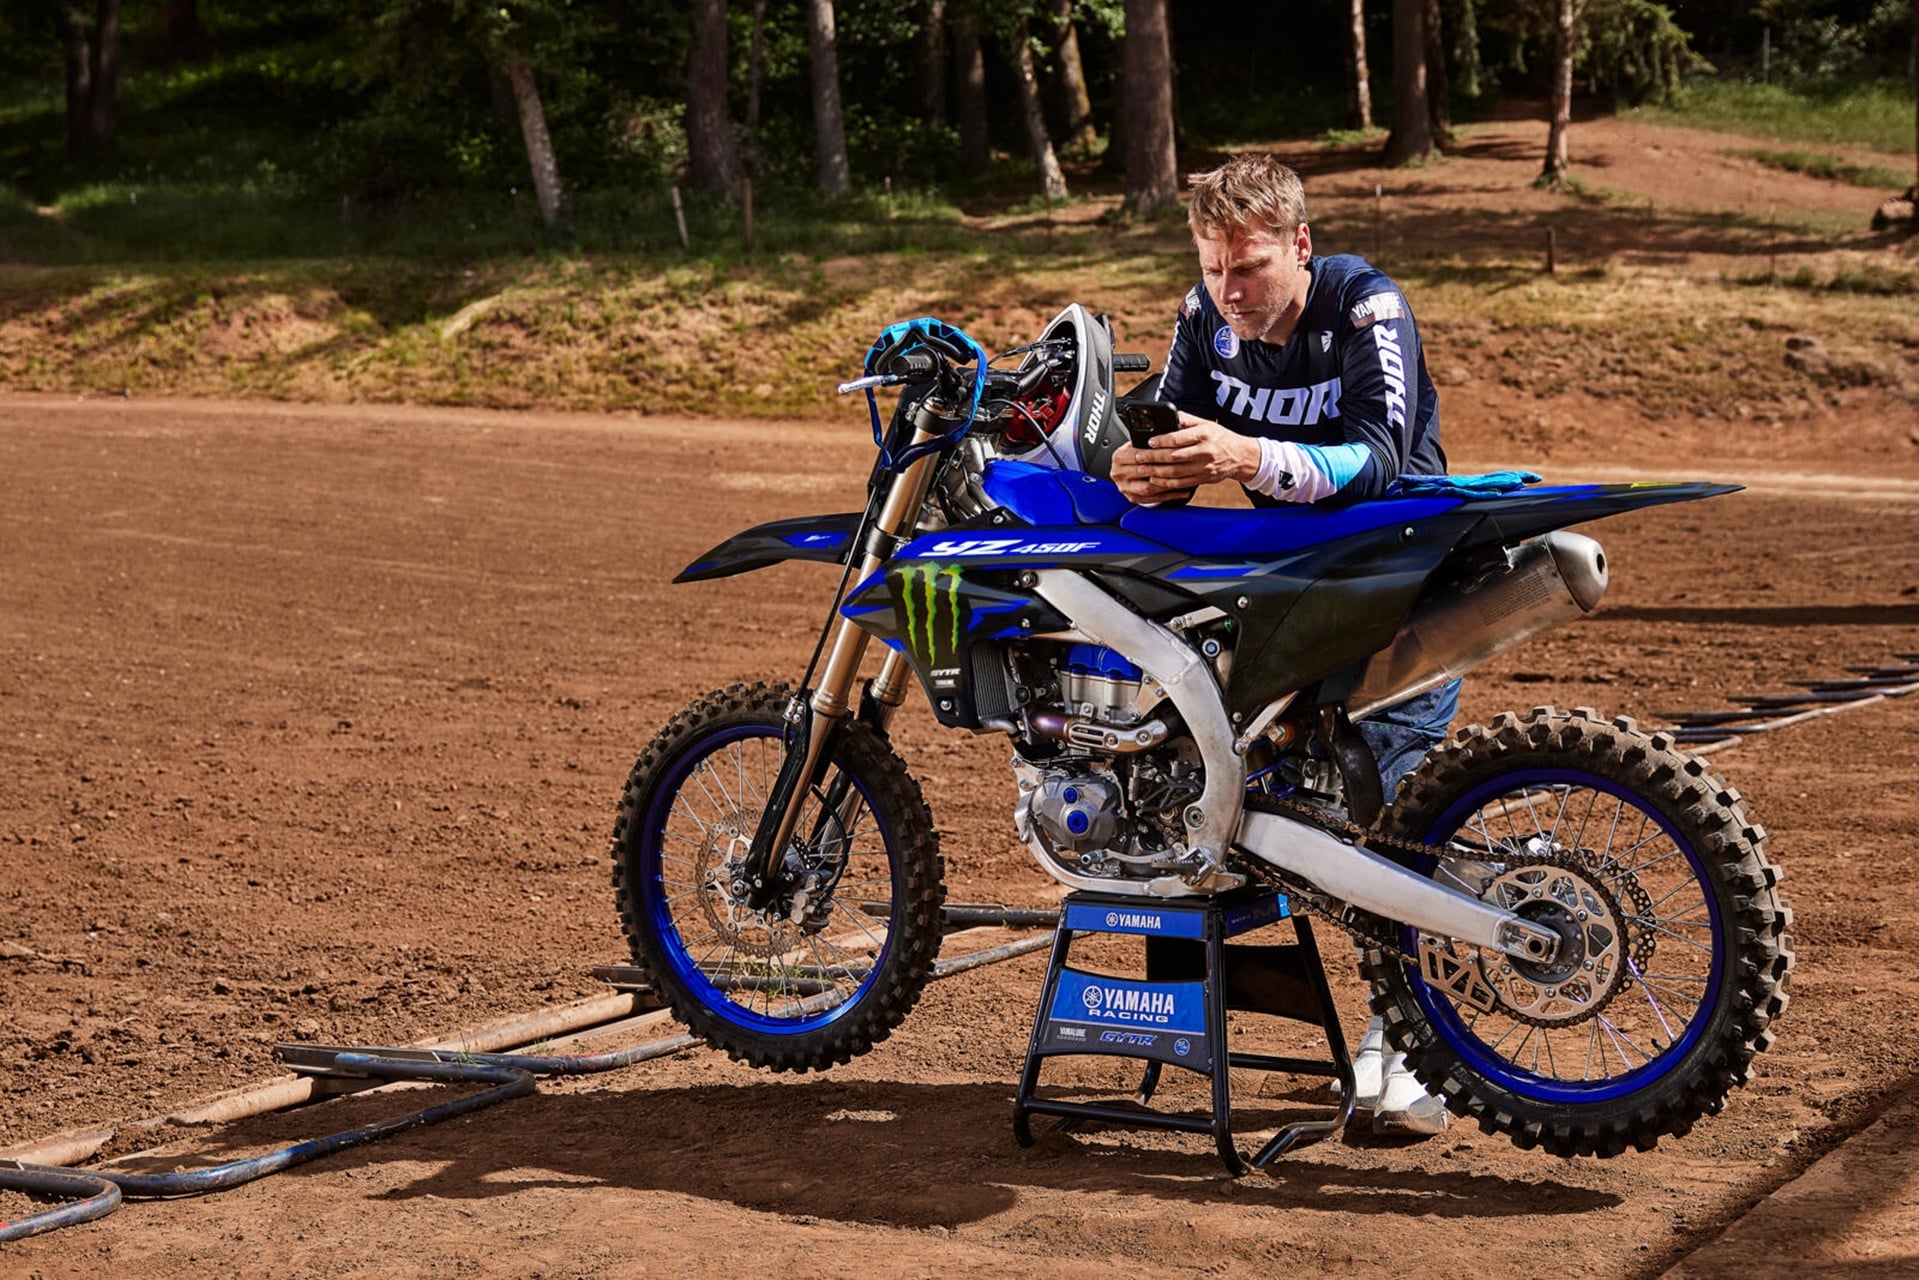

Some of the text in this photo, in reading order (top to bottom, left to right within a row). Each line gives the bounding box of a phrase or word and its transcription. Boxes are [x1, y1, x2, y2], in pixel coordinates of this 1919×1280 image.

[1372, 324, 1406, 429] THOR
[1210, 369, 1342, 425] THOR
[1084, 391, 1106, 445] THOR
[918, 539, 1102, 557] YZ 450F
[1119, 914, 1161, 929] YAMAHA
[1104, 988, 1175, 1015] YAMAHA
[1088, 1008, 1169, 1023] RACING
[1099, 1030, 1157, 1046] GYTR
